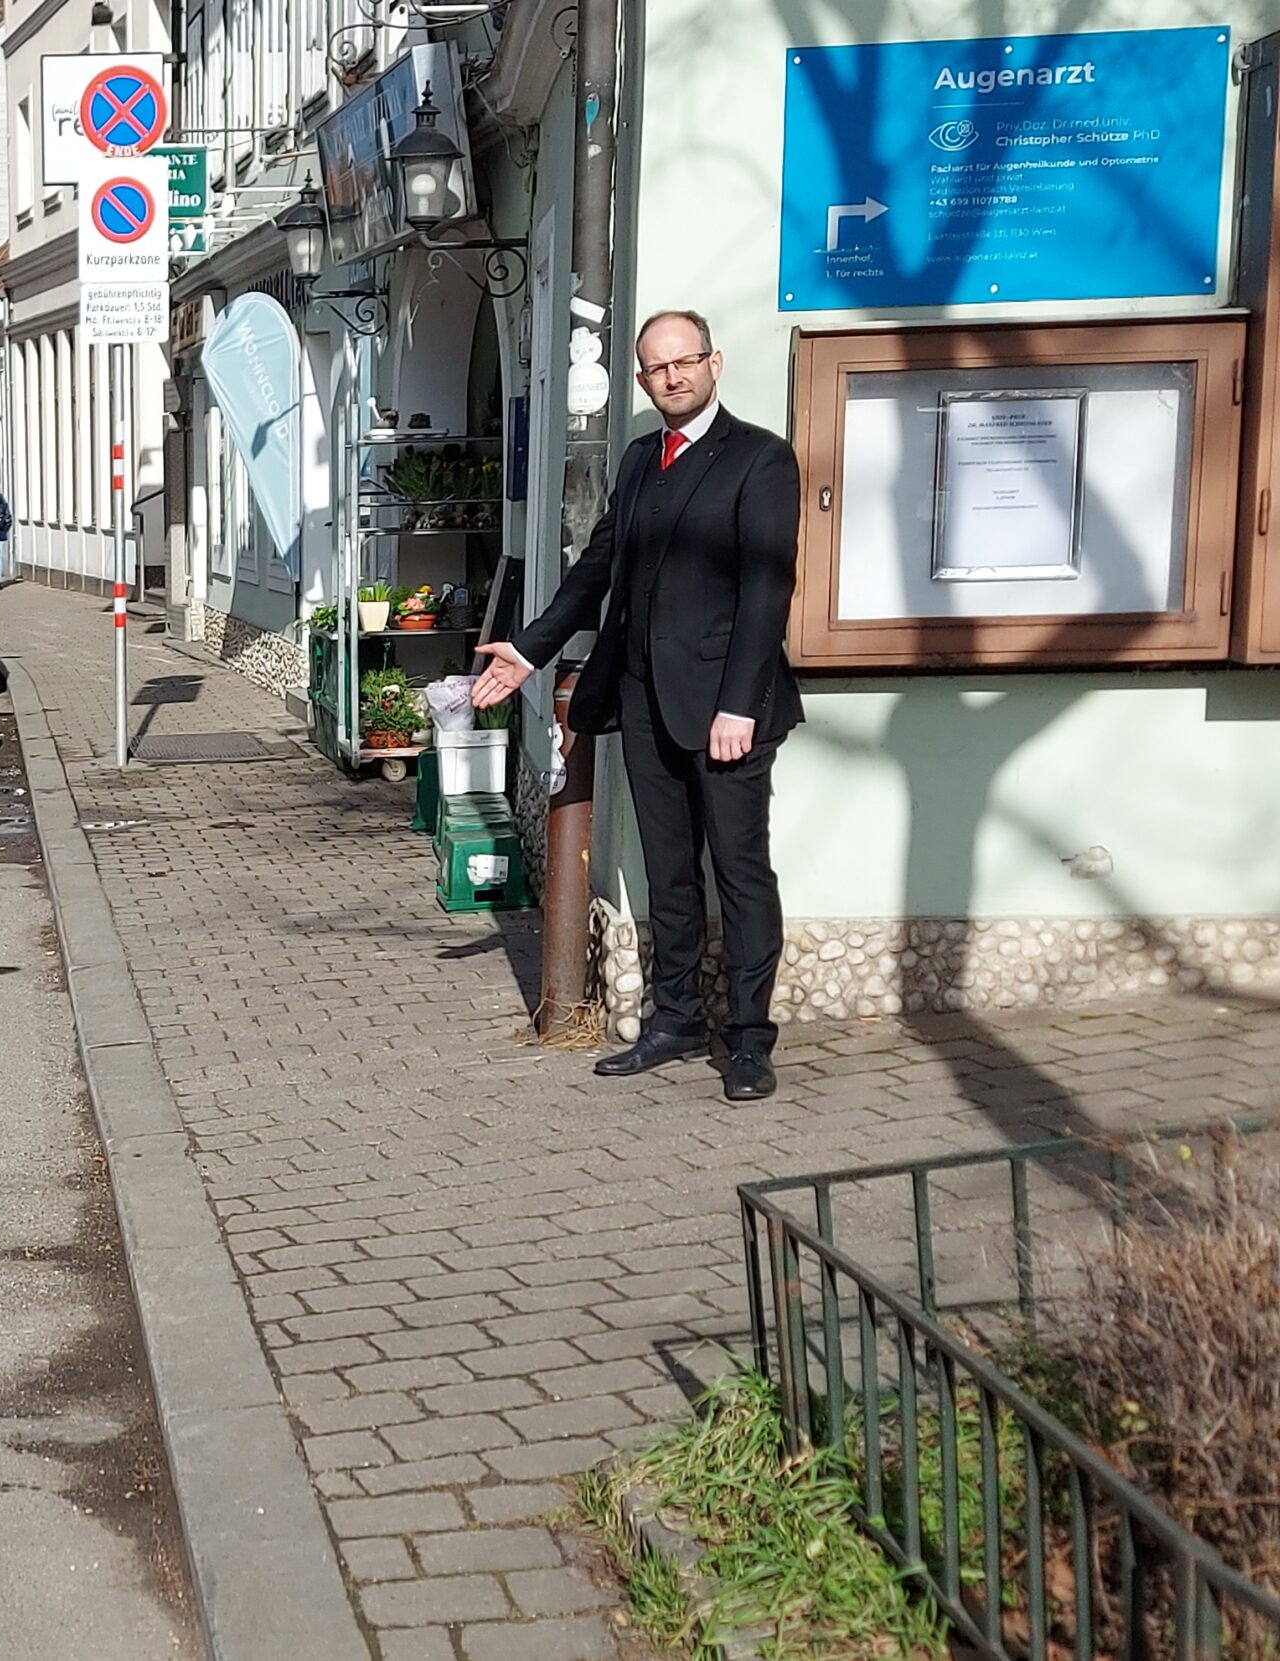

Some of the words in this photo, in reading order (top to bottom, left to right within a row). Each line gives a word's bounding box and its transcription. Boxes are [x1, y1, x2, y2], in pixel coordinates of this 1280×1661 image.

[934, 62, 1095, 93] Augenarzt
[995, 133, 1072, 147] Christopher
[1076, 131, 1129, 144] Schütze
[1133, 129, 1160, 140] PhD
[107, 144, 139, 157] ENDE
[931, 162, 973, 173] Facharzt
[976, 161, 990, 171] für
[993, 159, 1076, 173] Augenheilkunde
[1079, 157, 1098, 167] und
[1101, 155, 1159, 168] Optometrie
[86, 252, 160, 267] Kurzparkzone
[853, 268, 885, 278] rechts
[88, 287, 161, 301] gebührenpflichtig
[86, 302, 131, 312] Parkdauer:
